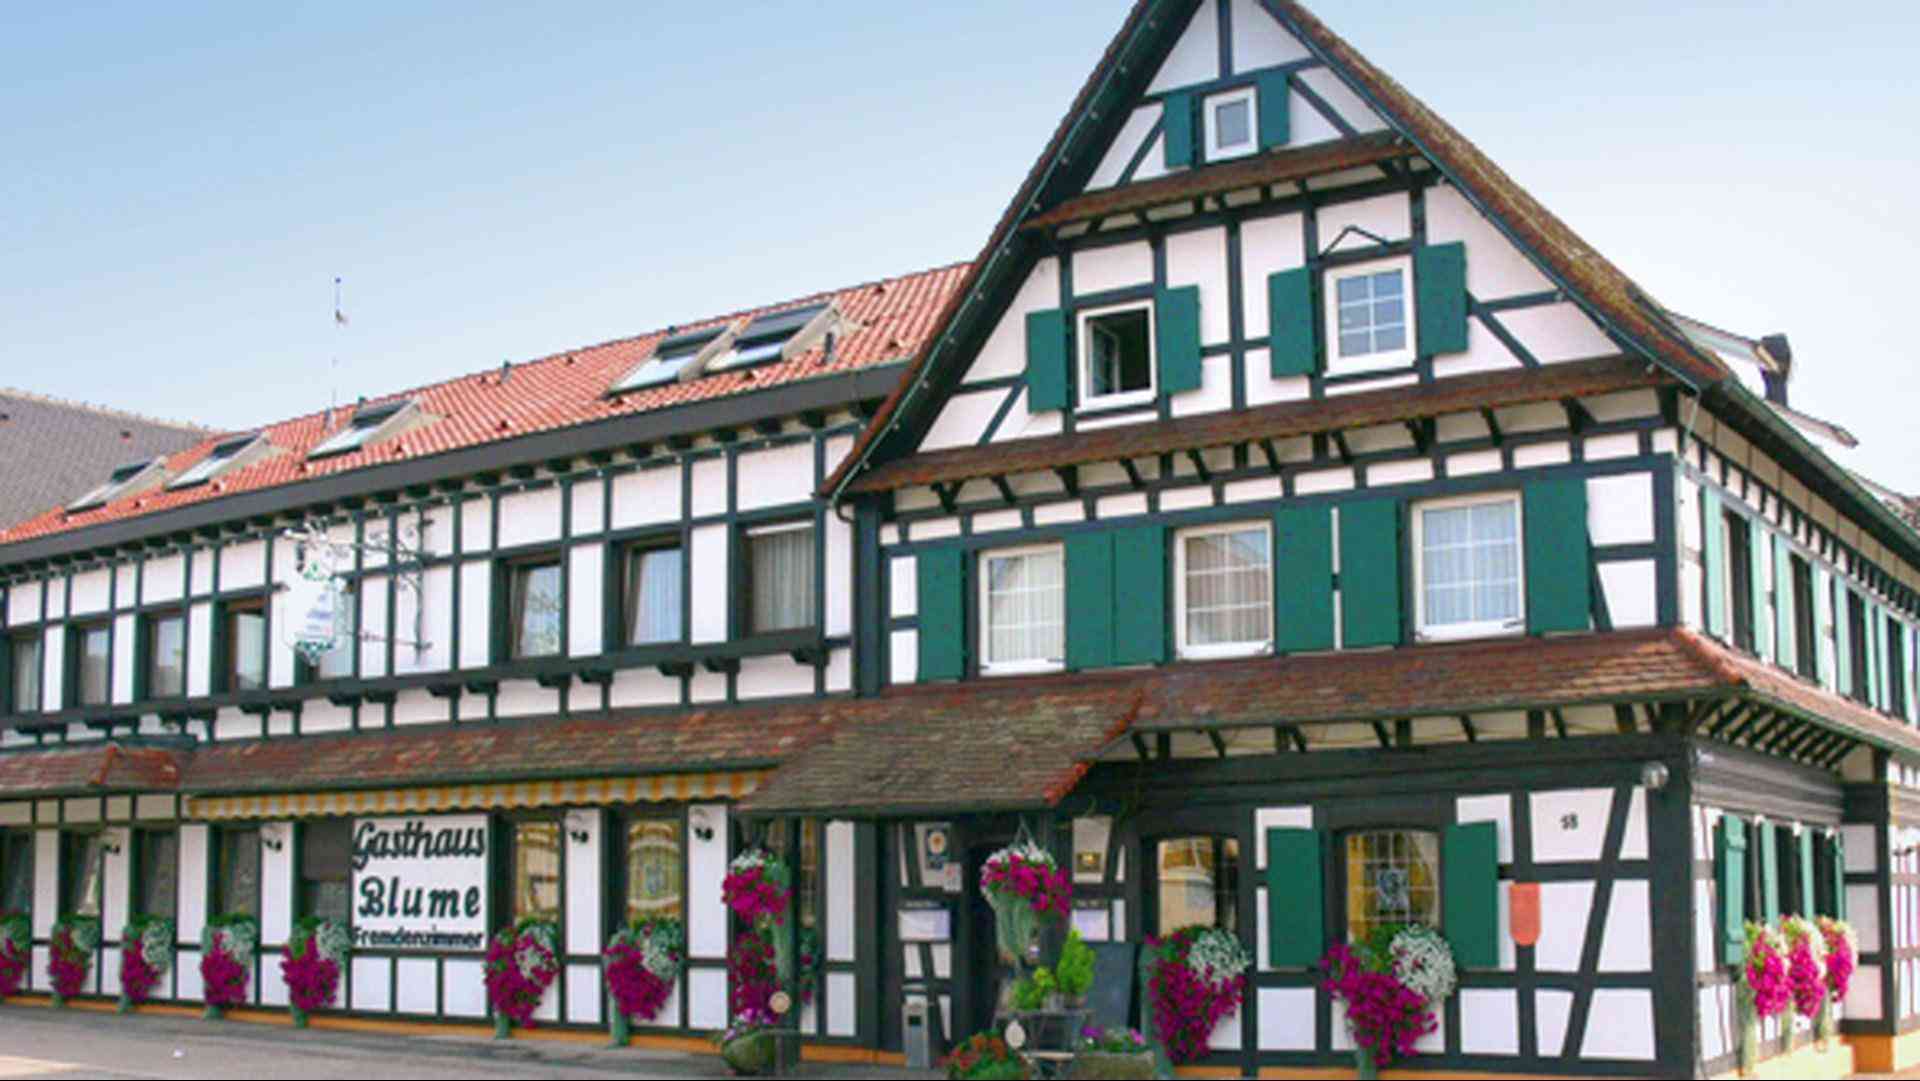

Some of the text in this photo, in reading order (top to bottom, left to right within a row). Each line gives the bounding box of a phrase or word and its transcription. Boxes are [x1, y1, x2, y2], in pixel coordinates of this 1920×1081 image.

[352, 821, 485, 871] Gasthaus
[358, 876, 480, 917] Blume
[352, 925, 483, 947] Fremdenzimmer
